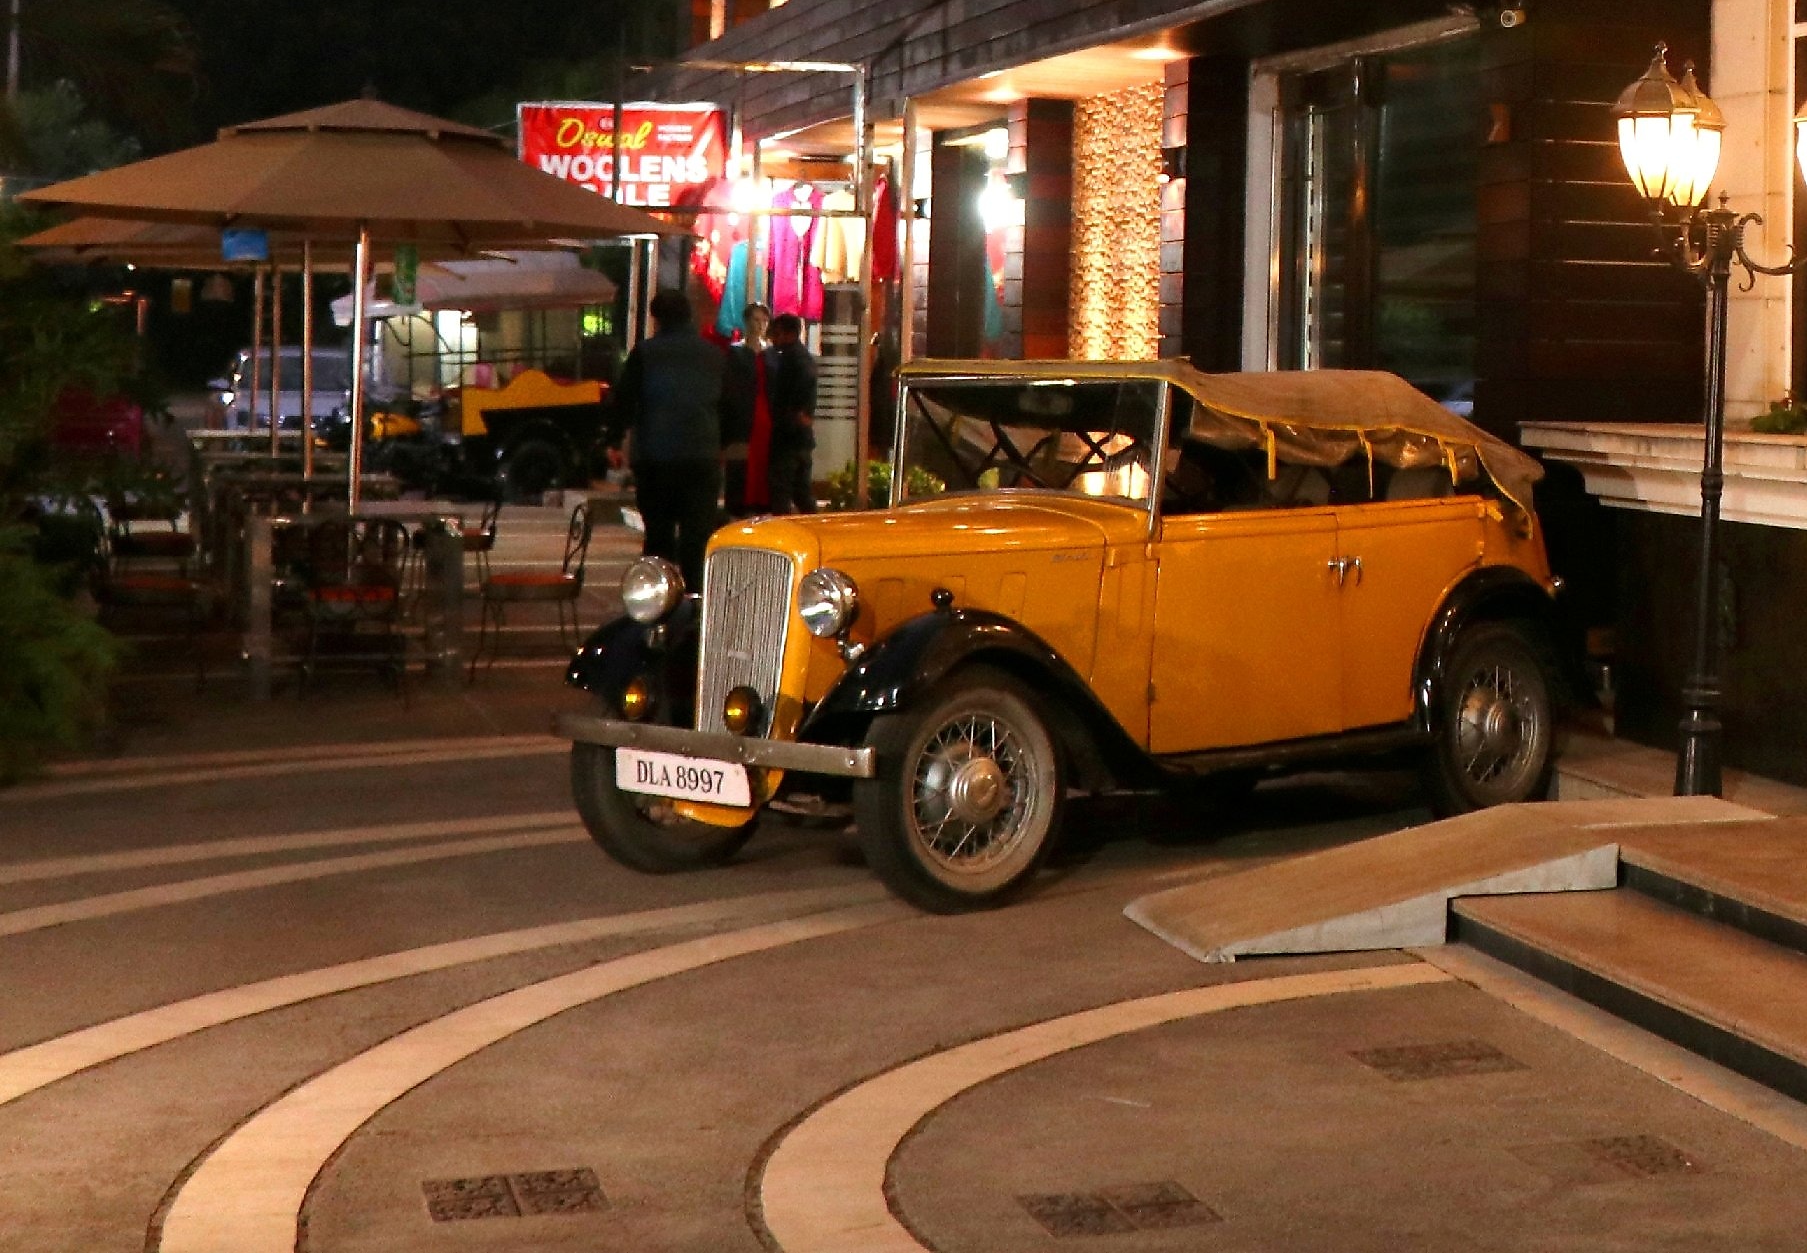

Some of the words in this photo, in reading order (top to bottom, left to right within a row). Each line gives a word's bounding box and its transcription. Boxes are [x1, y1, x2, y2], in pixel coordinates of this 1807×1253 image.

[556, 117, 654, 150] Oswal
[637, 760, 671, 787] DLA
[676, 765, 724, 794] 8997
